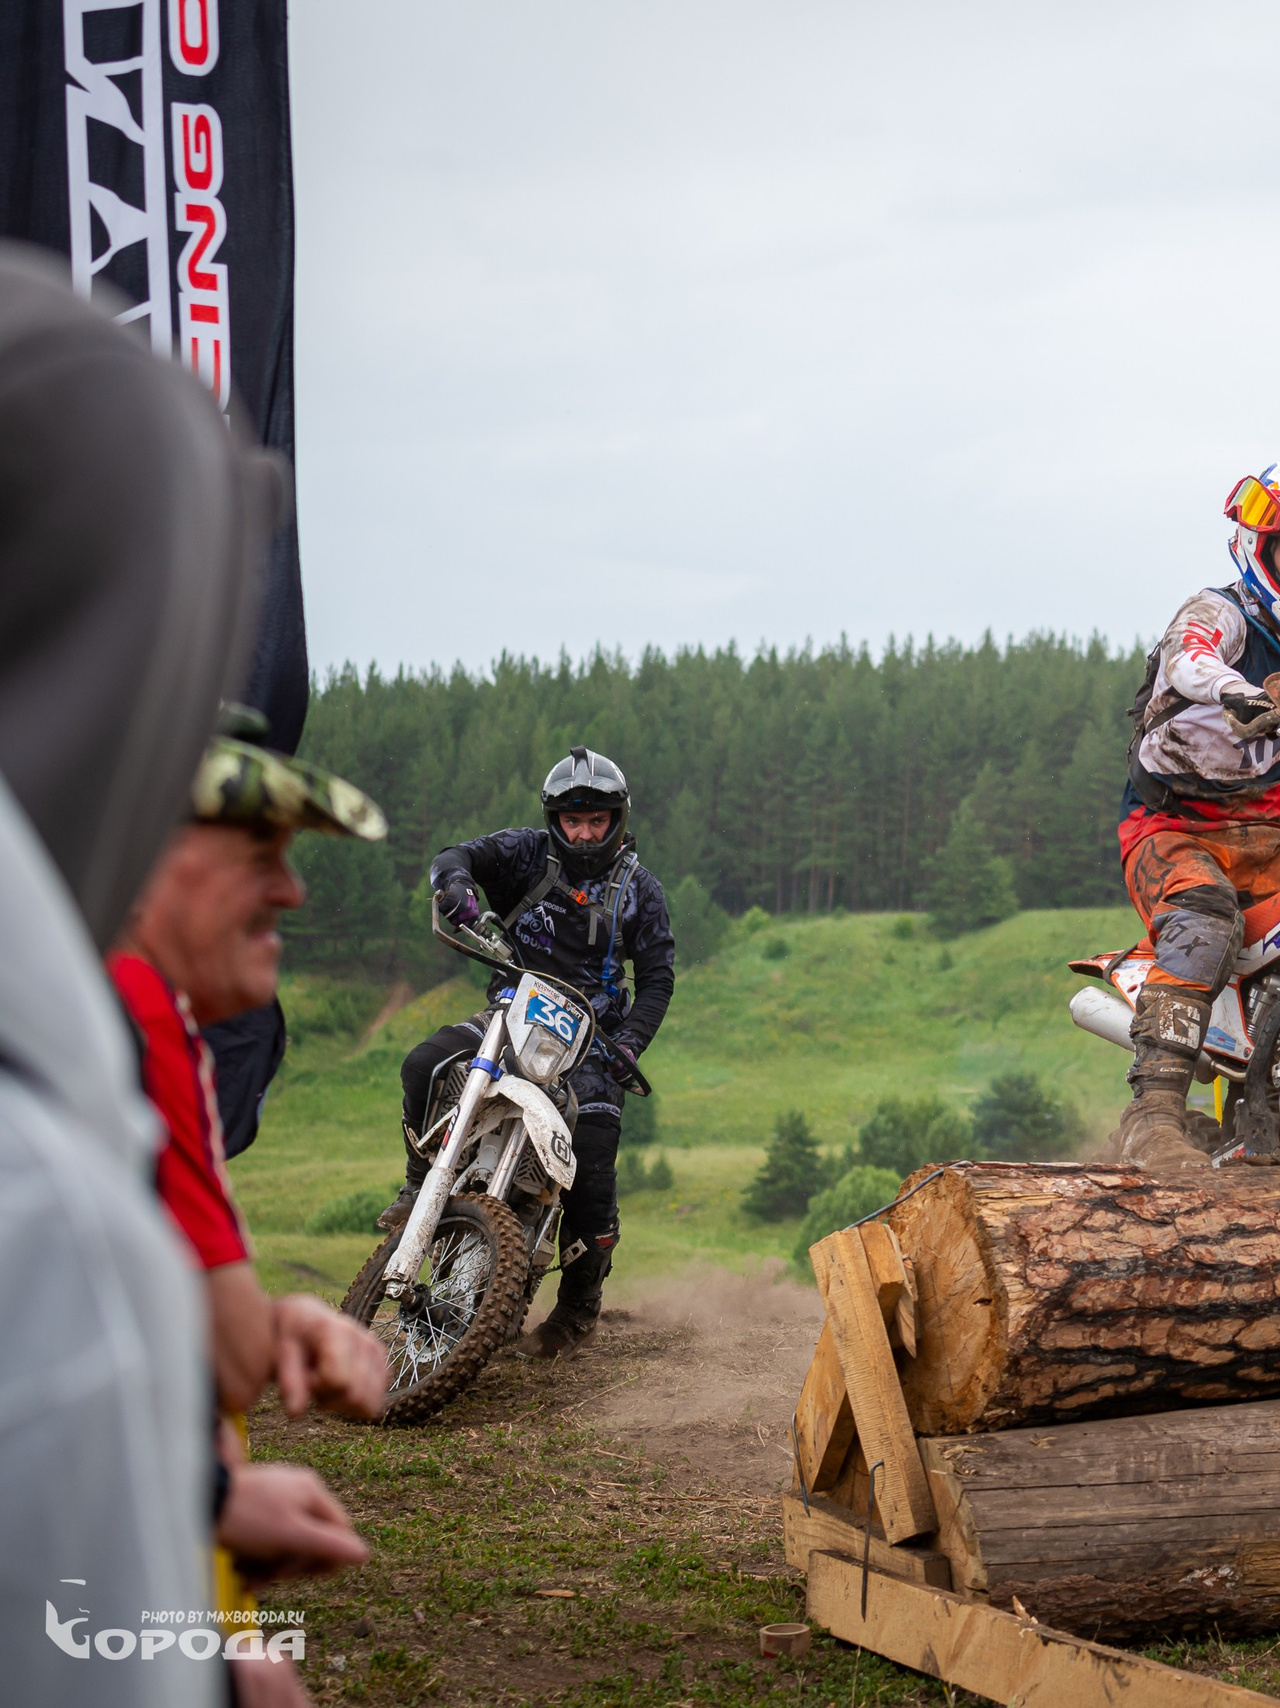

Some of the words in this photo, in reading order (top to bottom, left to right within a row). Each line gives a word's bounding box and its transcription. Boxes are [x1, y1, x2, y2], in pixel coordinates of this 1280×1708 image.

[171, 102, 231, 418] CING
[1246, 698, 1276, 711] THOR
[1166, 922, 1211, 958] OX
[534, 993, 575, 1041] 36
